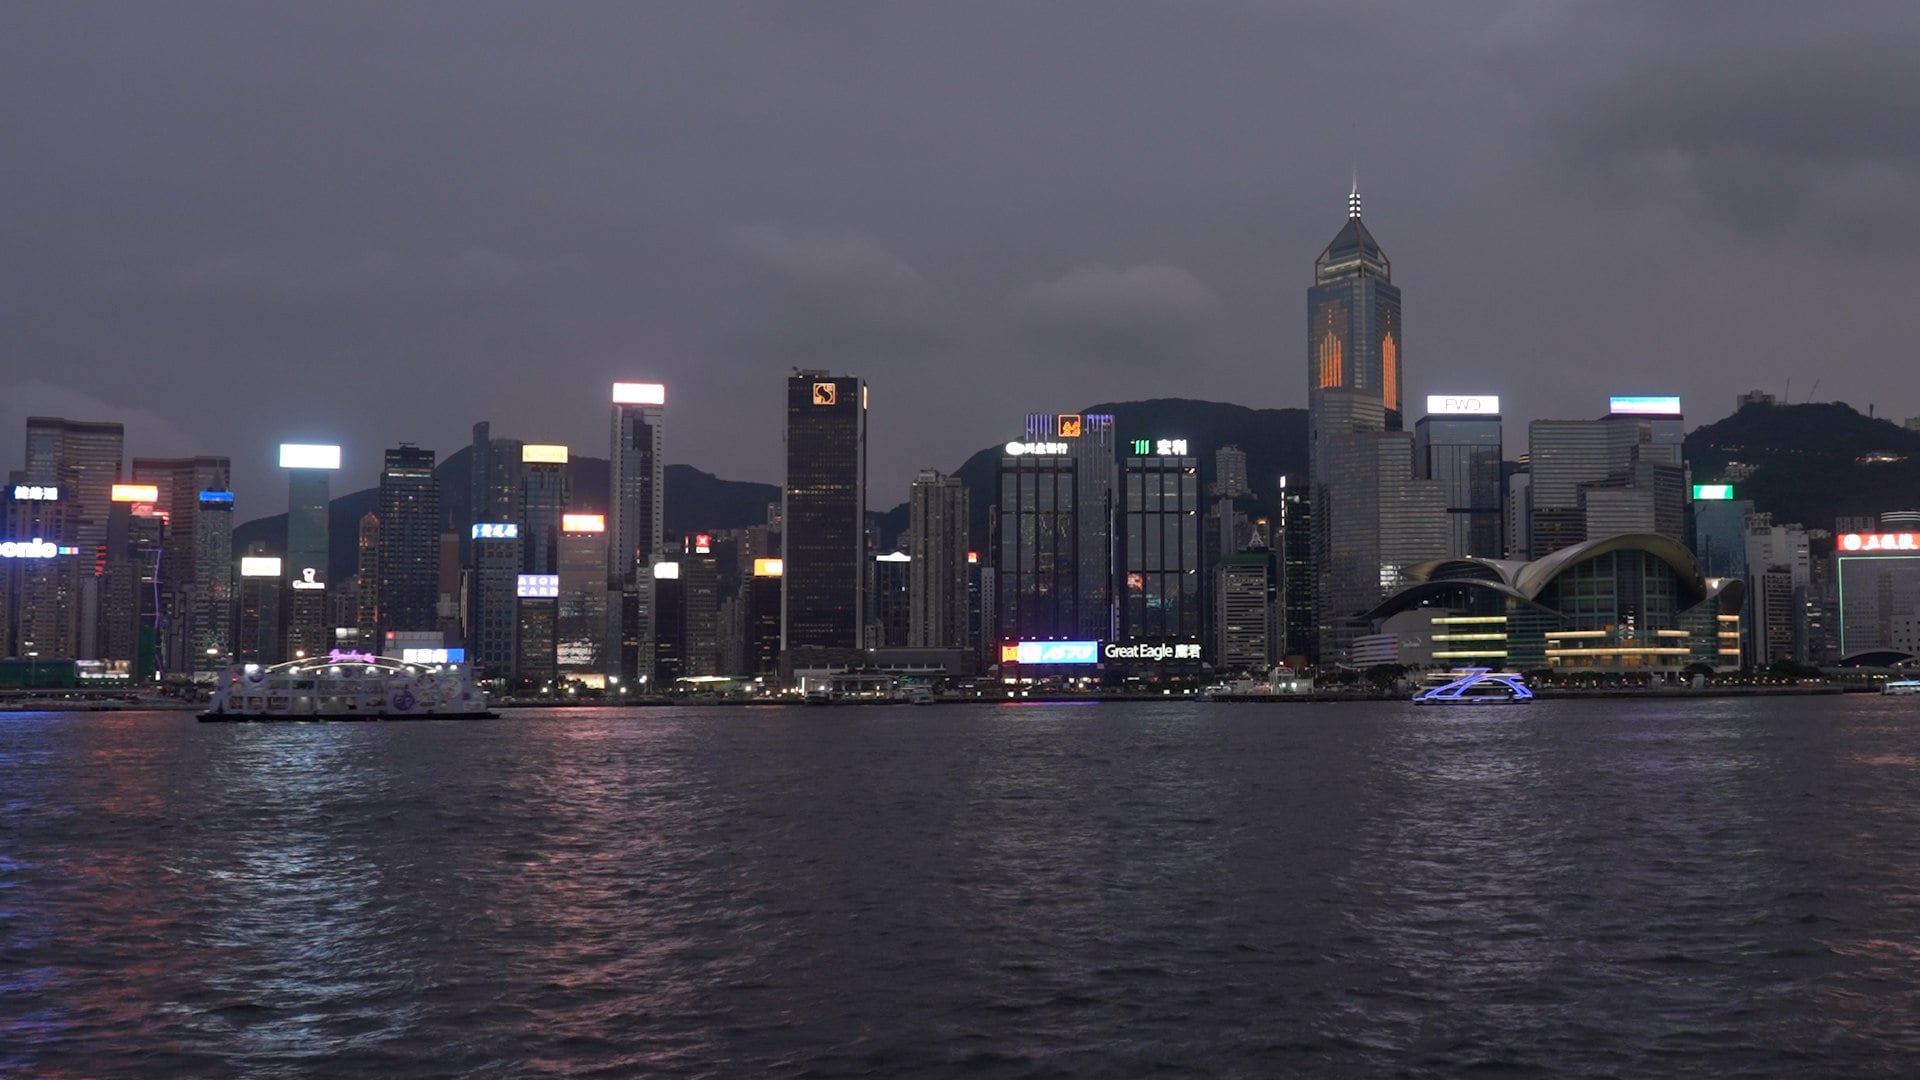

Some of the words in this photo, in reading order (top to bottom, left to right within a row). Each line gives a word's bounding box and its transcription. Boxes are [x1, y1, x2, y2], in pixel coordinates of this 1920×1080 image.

[518, 576, 558, 585] AEON
[518, 587, 558, 596] CARD
[1105, 644, 1139, 658] Great
[1140, 643, 1173, 660] Eagle
